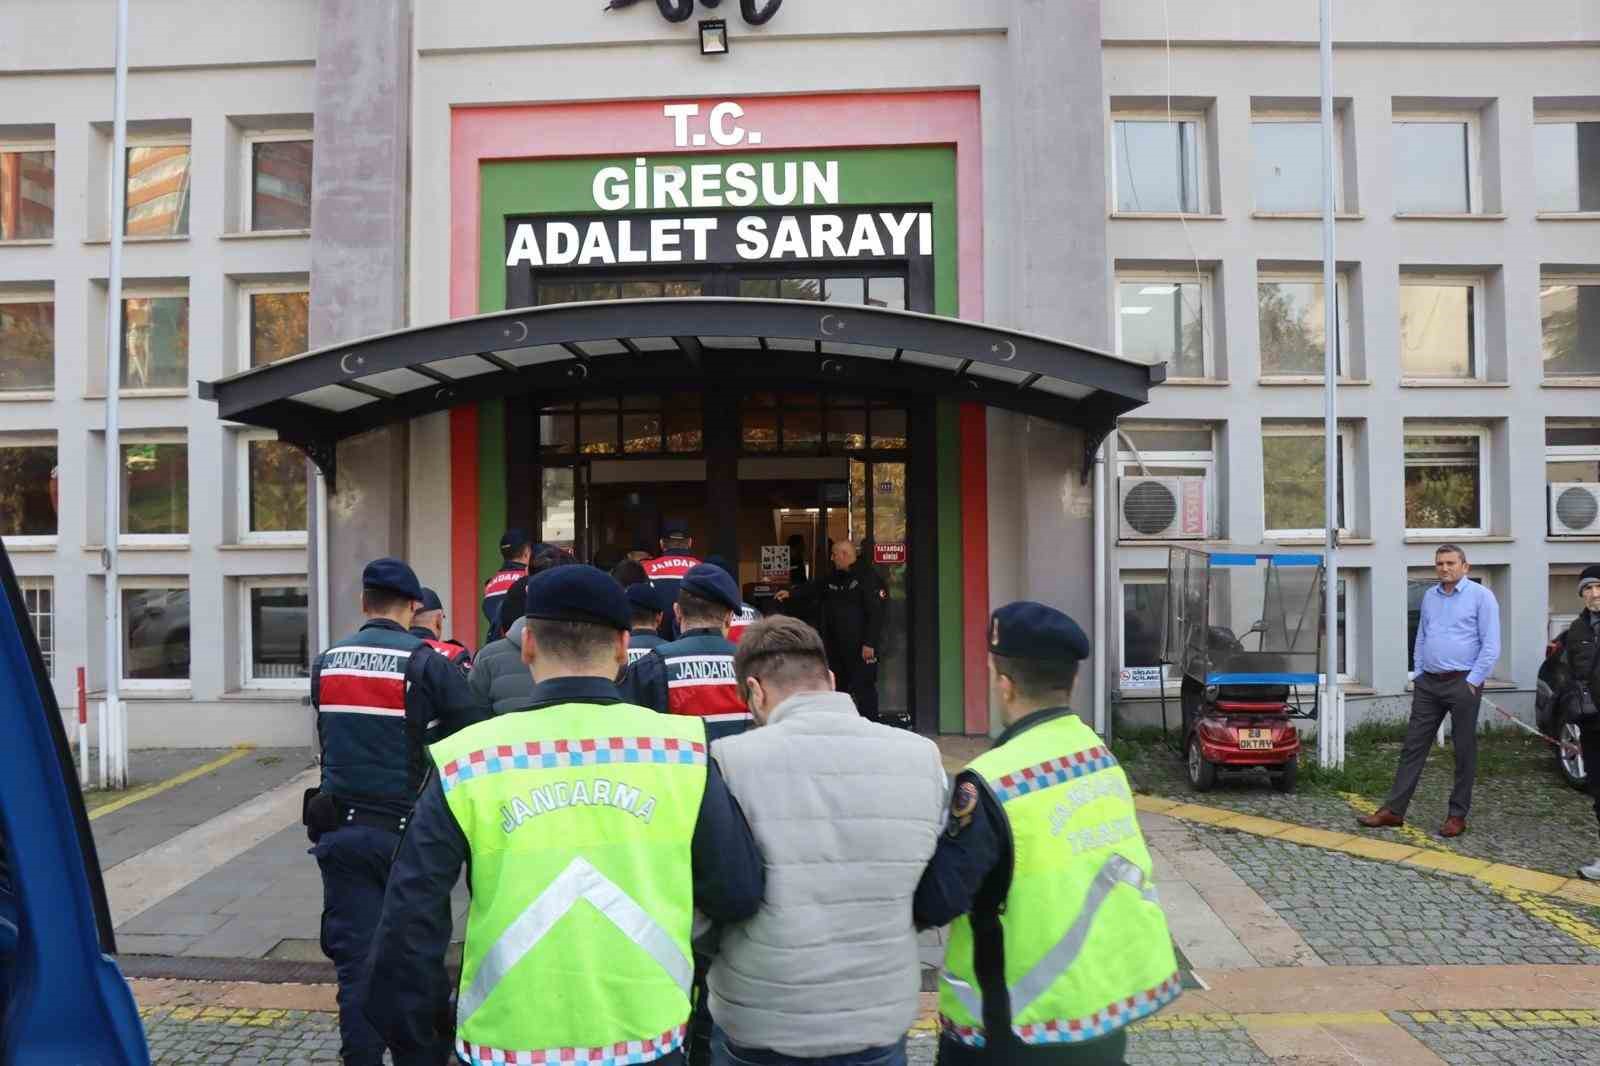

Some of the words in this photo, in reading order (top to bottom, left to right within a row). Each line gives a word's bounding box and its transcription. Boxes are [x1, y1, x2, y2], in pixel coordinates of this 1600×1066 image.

[663, 102, 763, 147] T.C.
[592, 157, 840, 211] GİRESUN
[506, 218, 718, 267] ADALET
[735, 213, 933, 259] SARAYI
[650, 558, 697, 573] JANDAR
[327, 652, 399, 673] JANDARMA
[675, 659, 736, 680] JANDARM
[500, 778, 657, 834] JANDARMA
